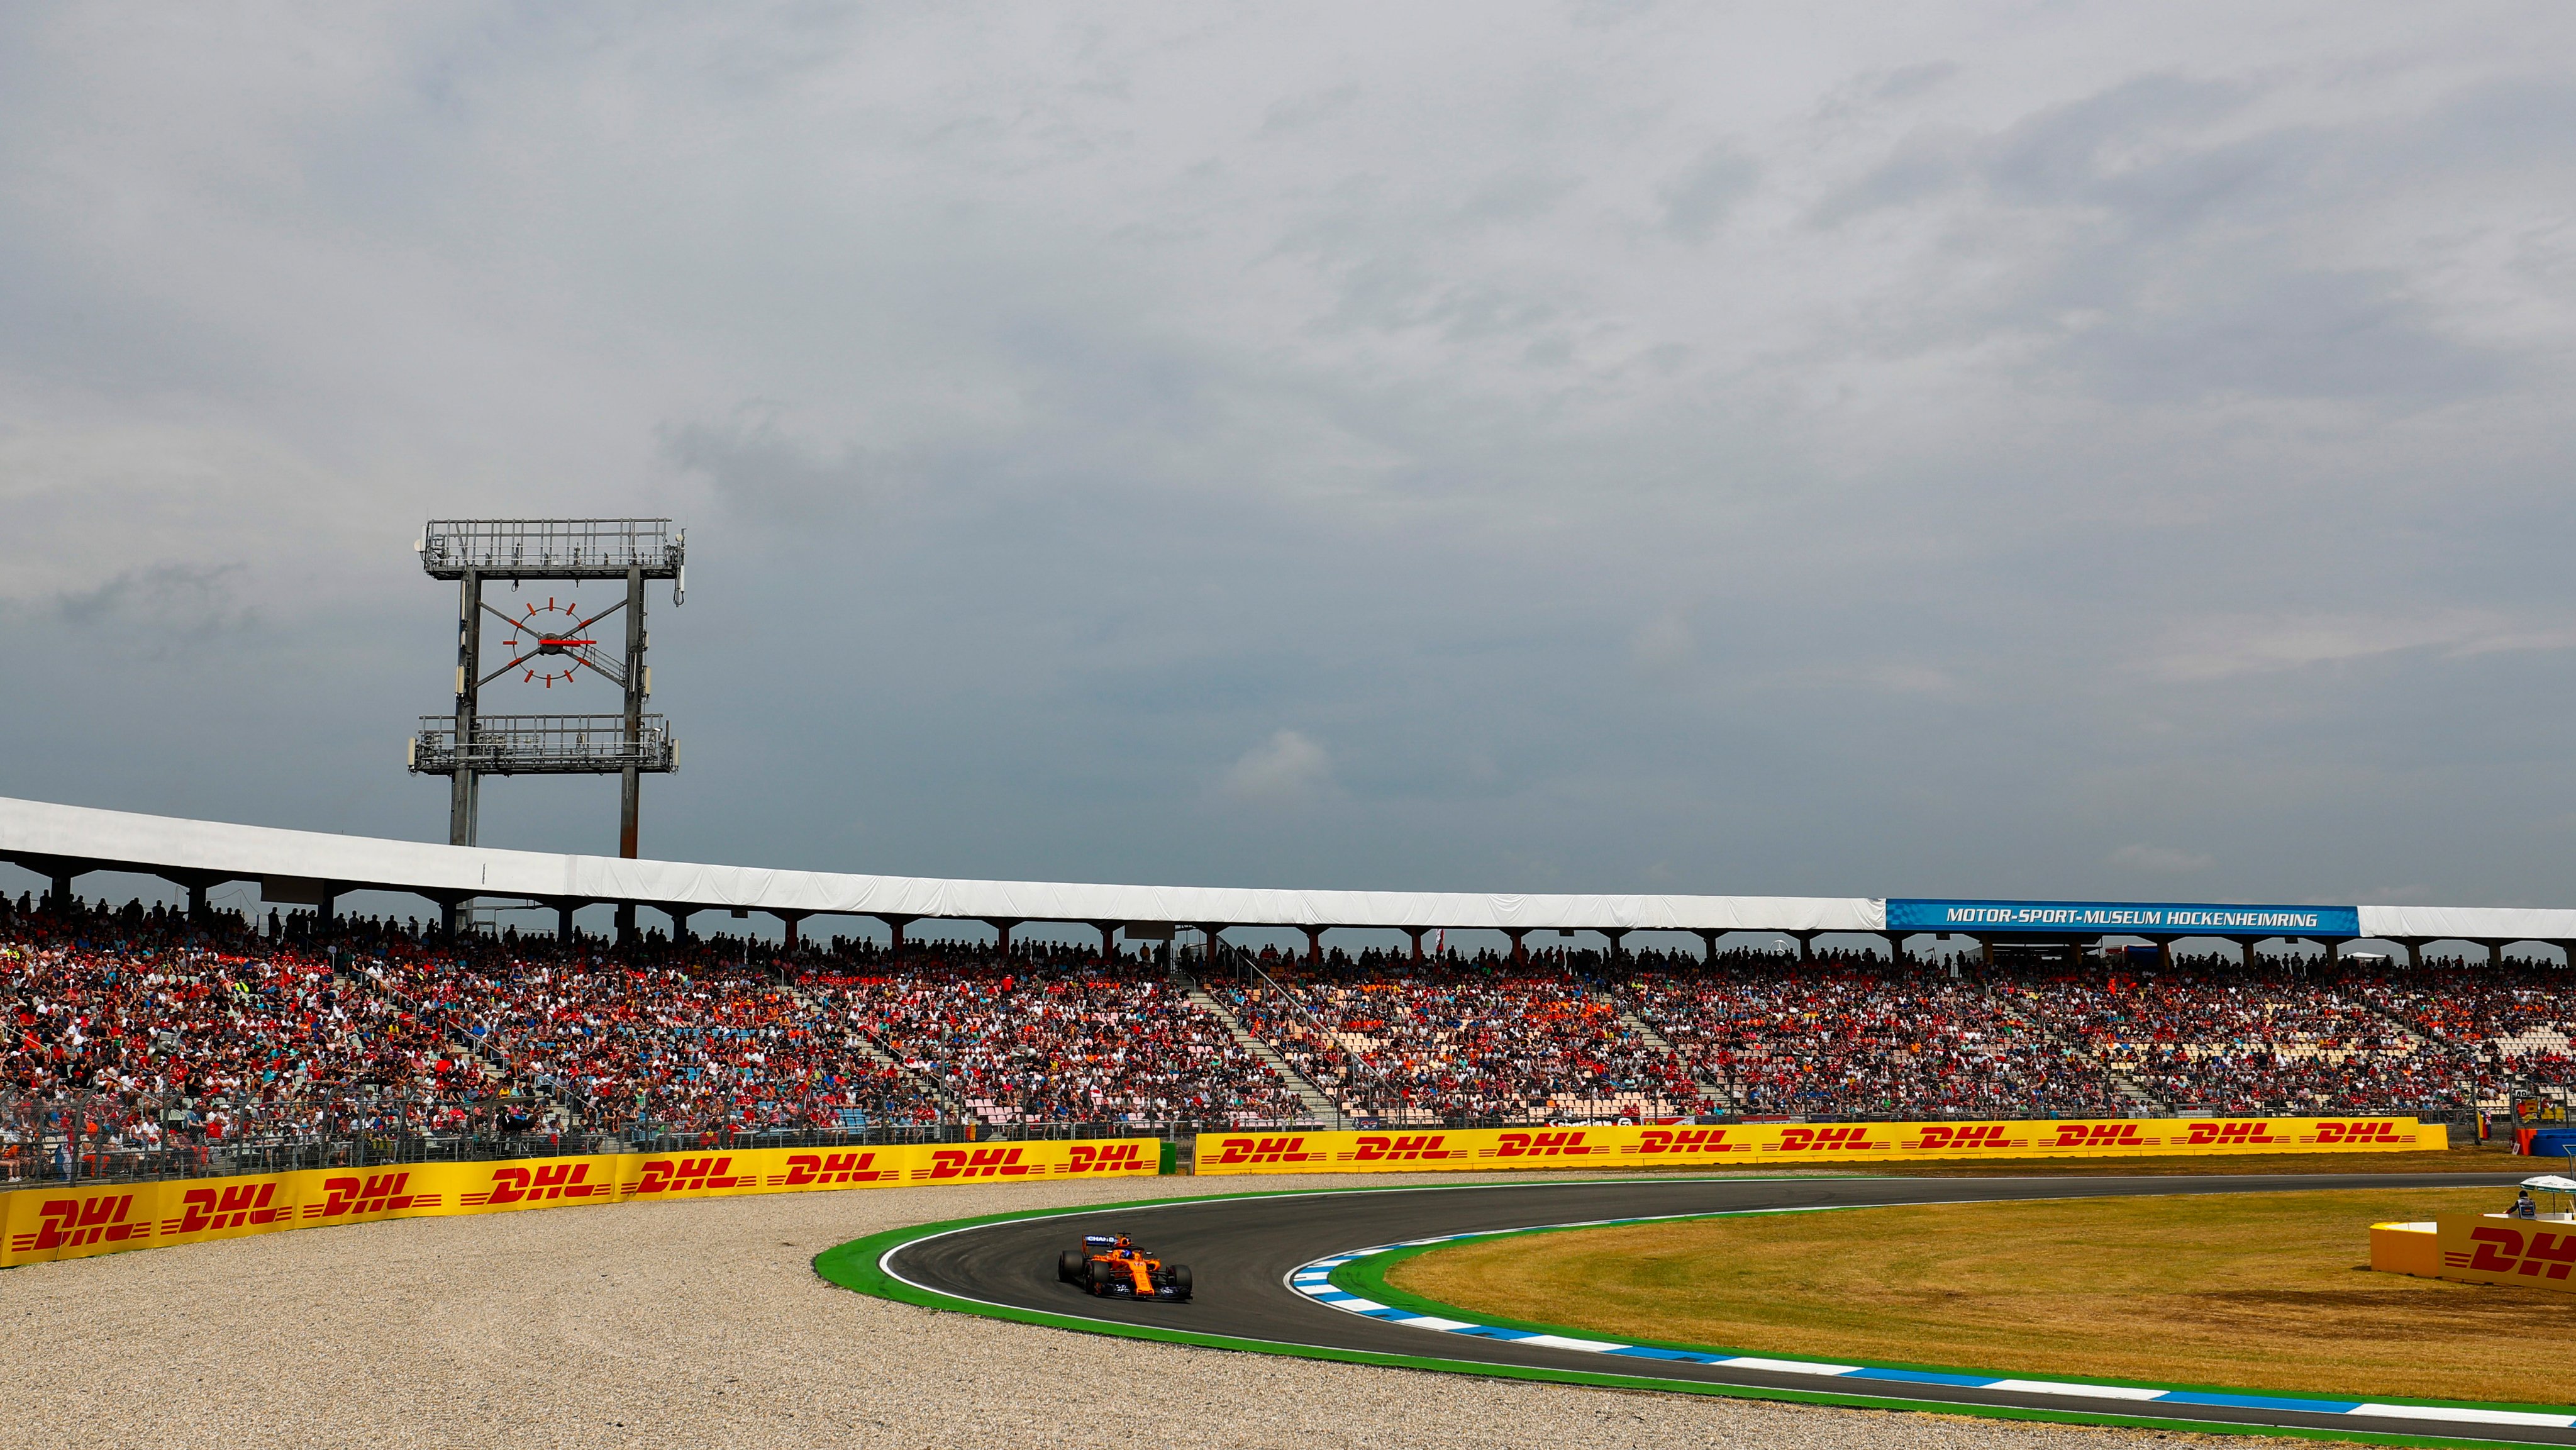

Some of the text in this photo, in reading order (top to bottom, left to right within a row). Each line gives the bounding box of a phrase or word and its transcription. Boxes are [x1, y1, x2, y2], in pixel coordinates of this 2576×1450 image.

[1946, 908, 2318, 927] MOTOR-SPORT-MUSEUM HOCKENHEIMRING
[1496, 1132, 1592, 1157] DHL
[1638, 1130, 1733, 1153] DHL
[1779, 1128, 1874, 1151] DHL
[1918, 1126, 2011, 1149] DHL
[2055, 1124, 2144, 1147] DHL
[2187, 1122, 2275, 1144] DHL
[2315, 1122, 2401, 1143] DHL
[1069, 1144, 1143, 1173] DHL
[1219, 1137, 1309, 1164] DHL
[1353, 1135, 1450, 1161] DHL
[632, 1157, 739, 1194] DHL
[784, 1152, 881, 1185] DHL
[929, 1148, 1030, 1179] DHL
[321, 1172, 415, 1217] DHL
[486, 1163, 596, 1205] DHL
[35, 1194, 135, 1249] DHL
[178, 1183, 279, 1234] DHL
